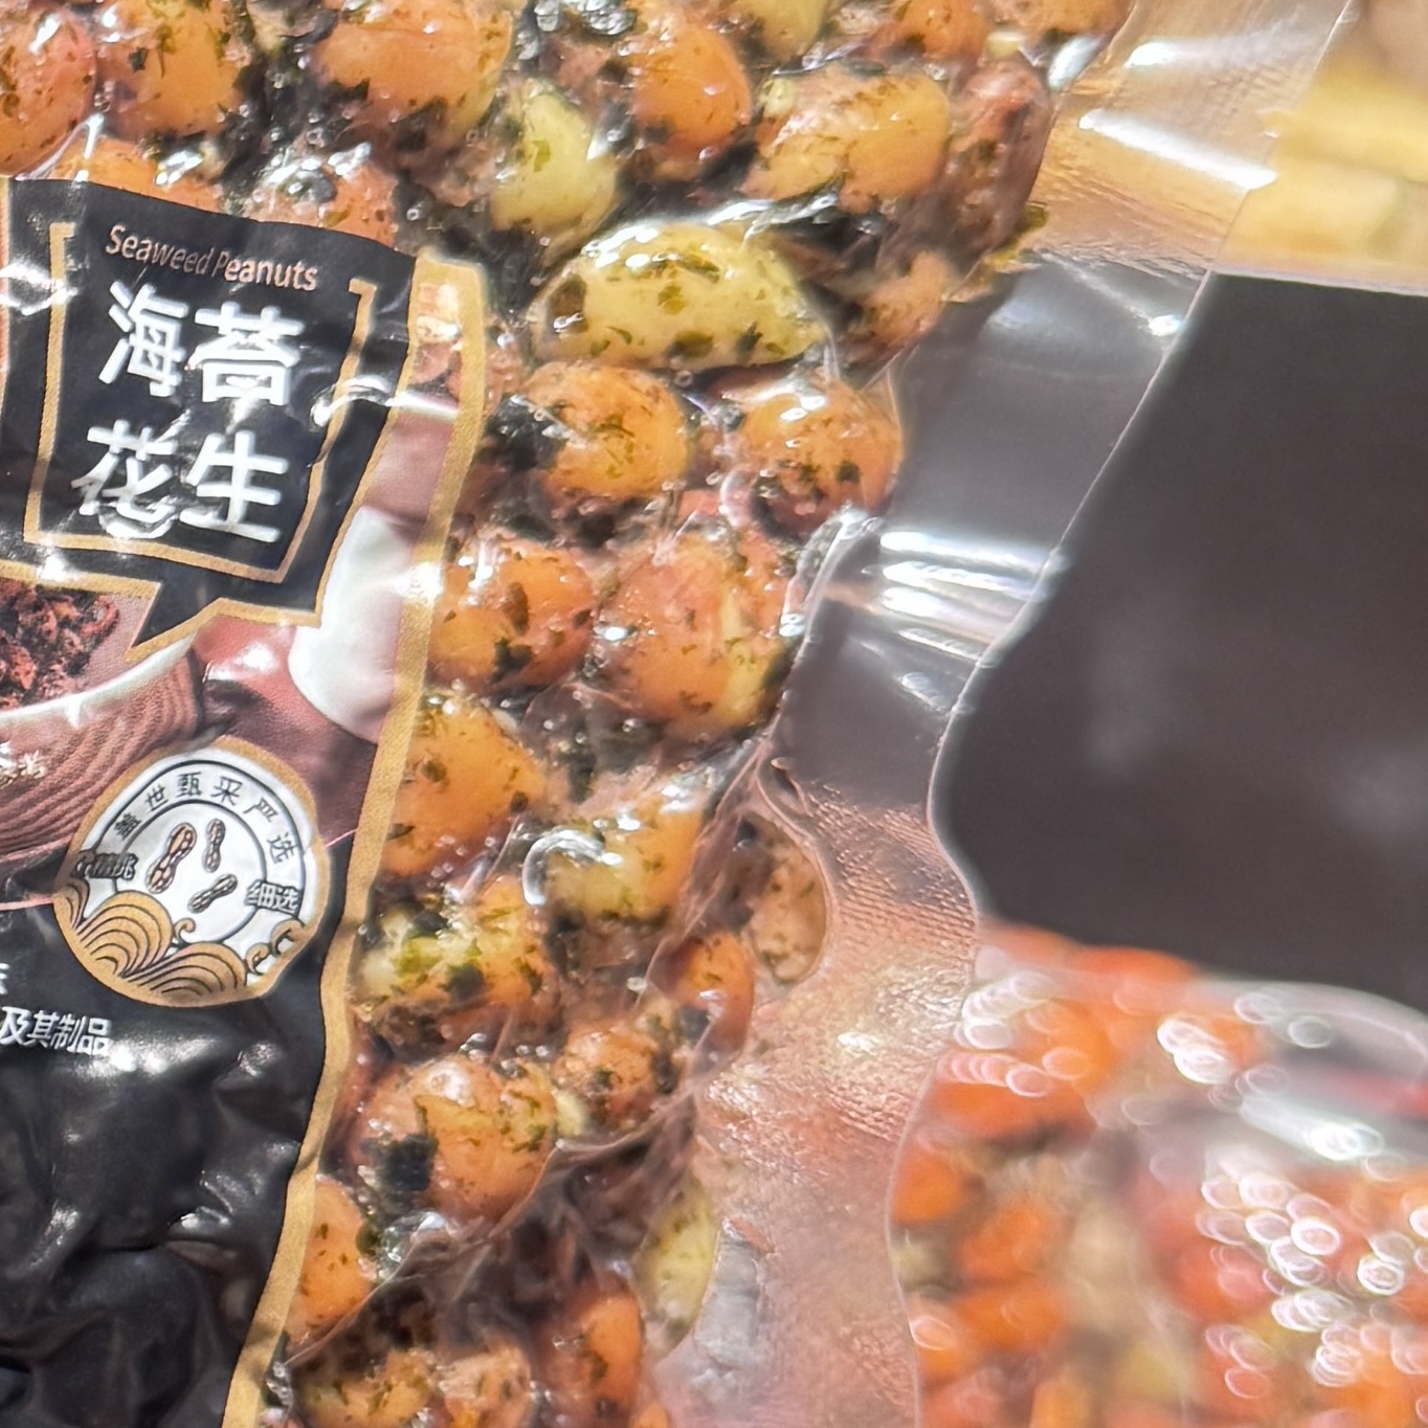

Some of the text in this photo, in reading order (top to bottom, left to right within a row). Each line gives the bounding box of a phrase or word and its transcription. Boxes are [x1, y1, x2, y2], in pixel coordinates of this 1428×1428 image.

[104, 223, 318, 293] Seaweed Peanuts
[98, 278, 305, 407] 海苔
[71, 419, 289, 544] 花生
